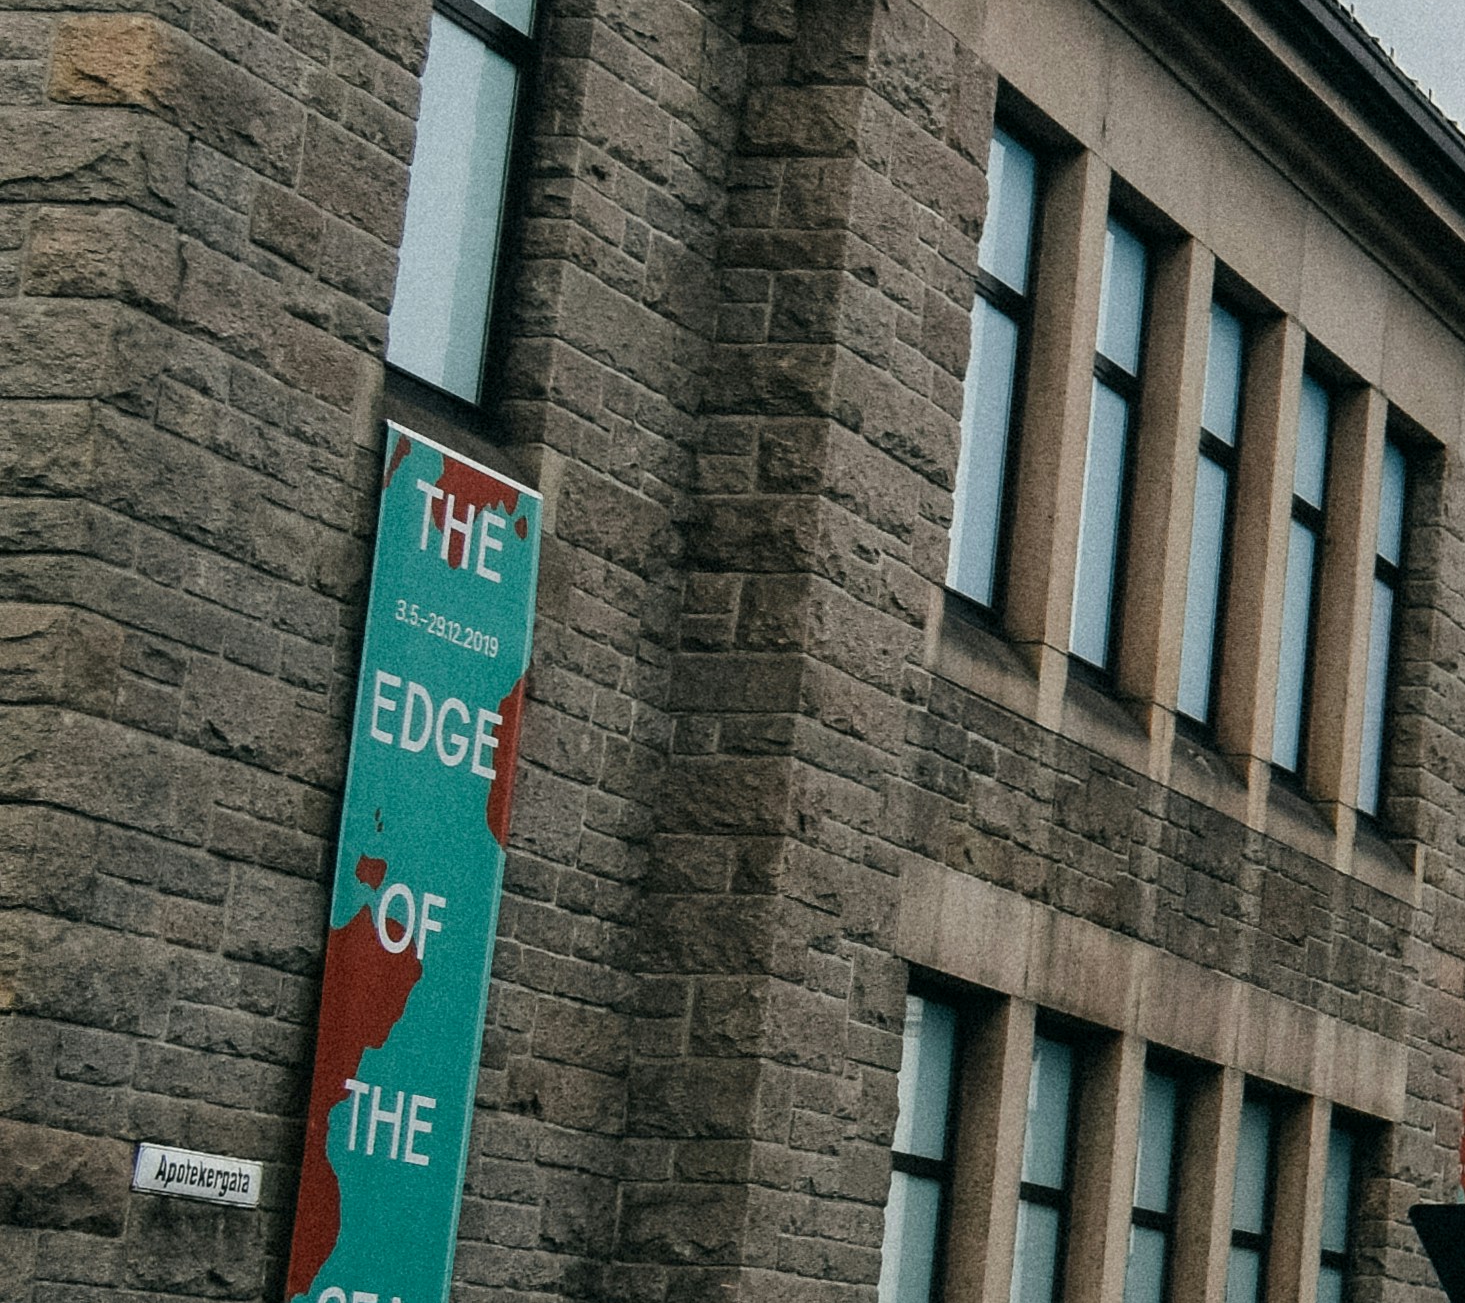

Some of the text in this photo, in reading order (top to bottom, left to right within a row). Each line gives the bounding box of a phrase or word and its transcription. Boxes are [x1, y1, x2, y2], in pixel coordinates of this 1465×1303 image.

[416, 478, 507, 584] THE
[395, 599, 499, 659] 3.5.-29.12.2019
[370, 669, 503, 780] EDGE
[376, 882, 447, 960] OF
[344, 1078, 437, 1166] THE
[154, 1154, 251, 1197] Apotekergata
